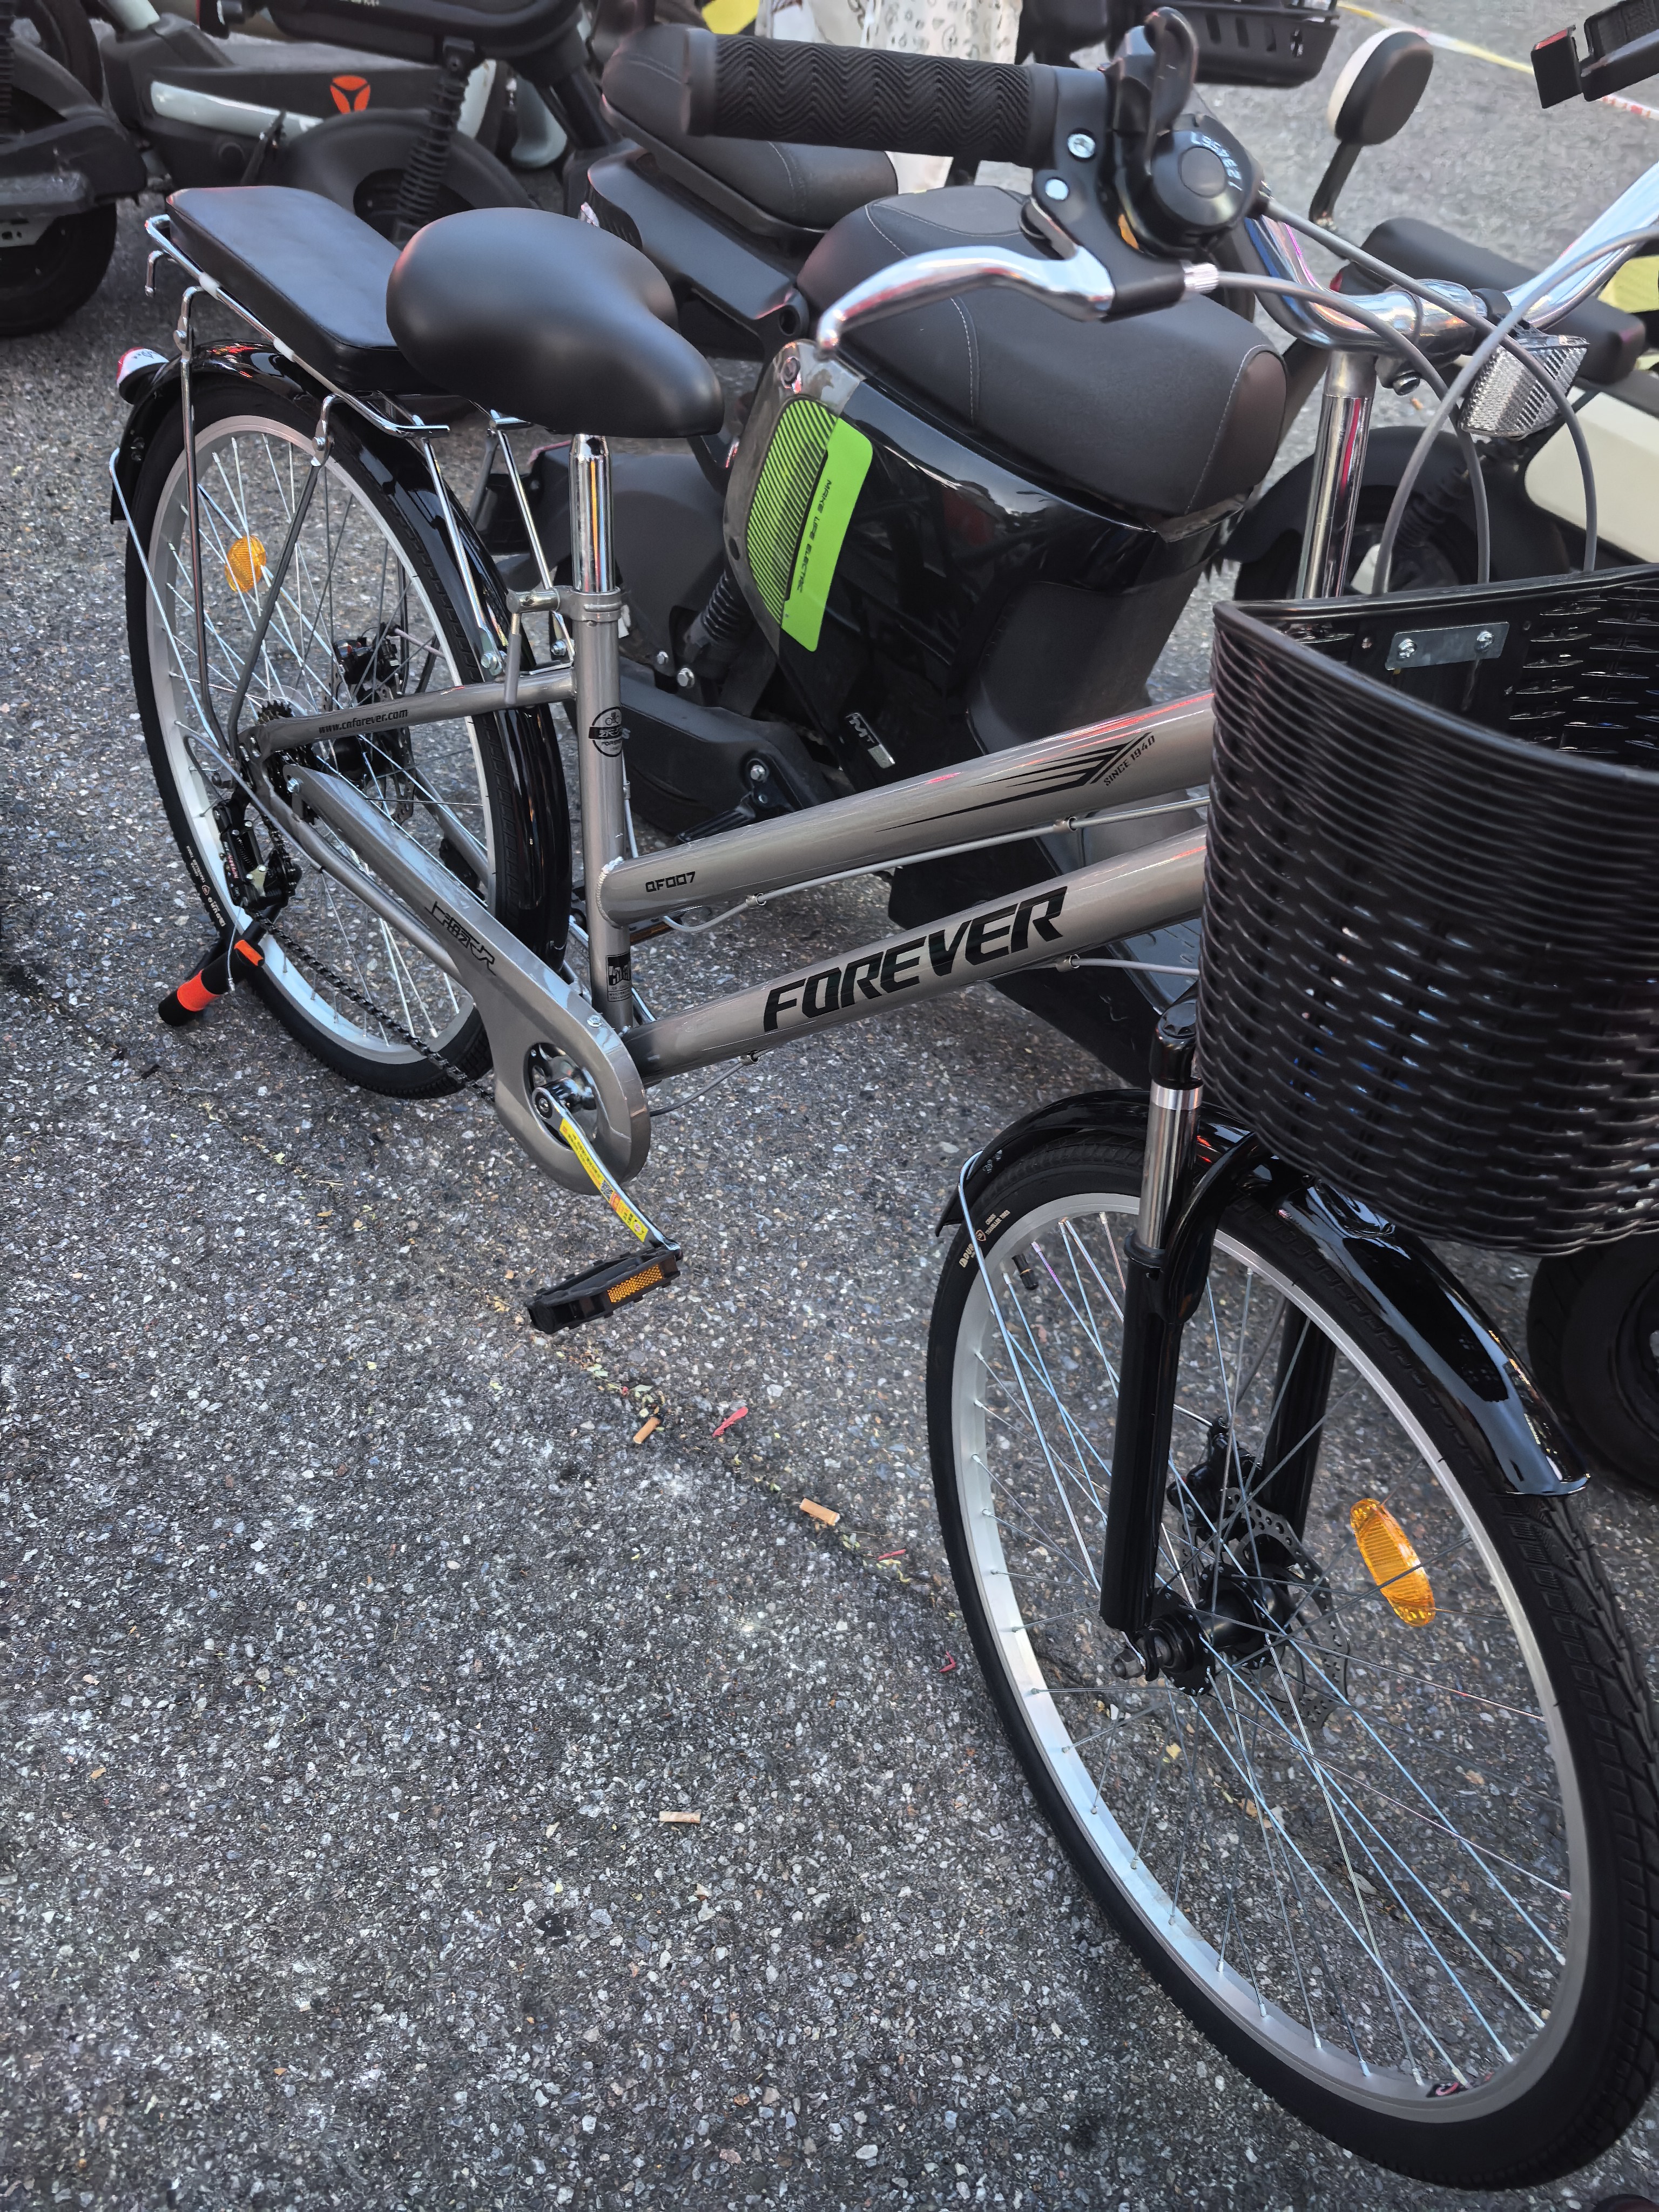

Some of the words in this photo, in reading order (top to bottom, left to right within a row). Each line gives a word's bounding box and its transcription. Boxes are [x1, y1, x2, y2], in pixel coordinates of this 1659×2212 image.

[1103, 759, 1131, 786] SINCE
[1130, 735, 1155, 761] 1940
[645, 871, 696, 893] QF007
[763, 886, 1068, 1033] FOREVER
